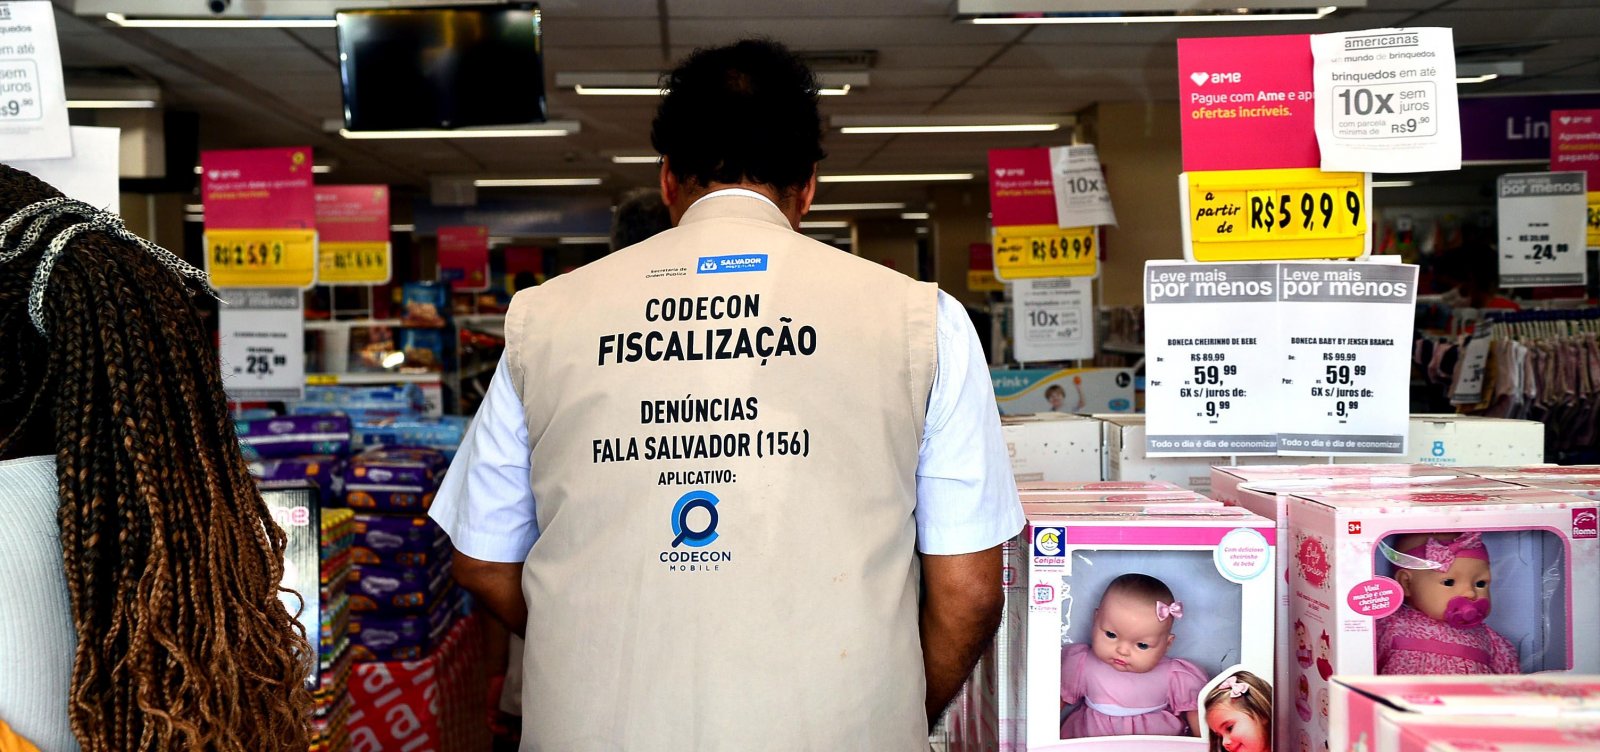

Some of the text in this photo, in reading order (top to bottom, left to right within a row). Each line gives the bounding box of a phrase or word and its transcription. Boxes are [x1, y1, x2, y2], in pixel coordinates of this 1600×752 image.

[1344, 35, 1419, 48] americanas
[1389, 51, 1436, 60] brinquedos
[1332, 67, 1436, 83] brinquedos em até
[1191, 93, 1227, 106] Pague
[1230, 93, 1254, 102] com
[1257, 91, 1285, 101] Ame
[1288, 91, 1296, 100] e
[1399, 89, 1426, 99] sem
[1338, 88, 1395, 115] 10x
[1399, 101, 1430, 114] juros
[1191, 105, 1292, 119] ofertas incríveis.
[1357, 120, 1386, 128] parcela
[1068, 177, 1099, 193] 10x
[1530, 183, 1581, 193] menos
[1205, 192, 1214, 201] a
[1196, 204, 1241, 221] partir
[1217, 221, 1234, 233] de
[720, 258, 762, 266] SALVADOR
[1150, 268, 1227, 282] Leve mais
[1283, 268, 1361, 281] Leve mais
[1150, 280, 1273, 301] por menos
[1283, 281, 1407, 299] por menos
[645, 293, 760, 322] CODECON
[1028, 311, 1059, 326] 10x
[598, 316, 817, 366] FISCALIZAÇÃO
[1195, 338, 1230, 346] CHEIRINHO
[1191, 353, 1200, 362] R$
[1323, 353, 1333, 361] R$
[1180, 388, 1247, 398] 6X s/ juros de:
[1311, 387, 1374, 398] 6X s/ juros de:
[641, 394, 758, 424] DENÚNCIAS
[592, 428, 810, 463] FALA SALVADOR (156)
[1151, 440, 1172, 448] Todo
[1182, 440, 1194, 448] dia
[1196, 439, 1201, 447] é
[1203, 440, 1216, 448] dia
[1218, 440, 1229, 448] de
[1230, 439, 1277, 448] economizar
[1281, 438, 1303, 447] Todo
[1311, 439, 1324, 447] dia
[1325, 439, 1331, 447] é
[1332, 439, 1345, 447] dia
[1346, 440, 1356, 448] de
[1357, 440, 1401, 448] economizar
[658, 469, 737, 485] APLICATIVO:
[1348, 524, 1361, 532] 3+
[659, 551, 731, 562] CODECON
[1359, 597, 1389, 606] cheirinho
